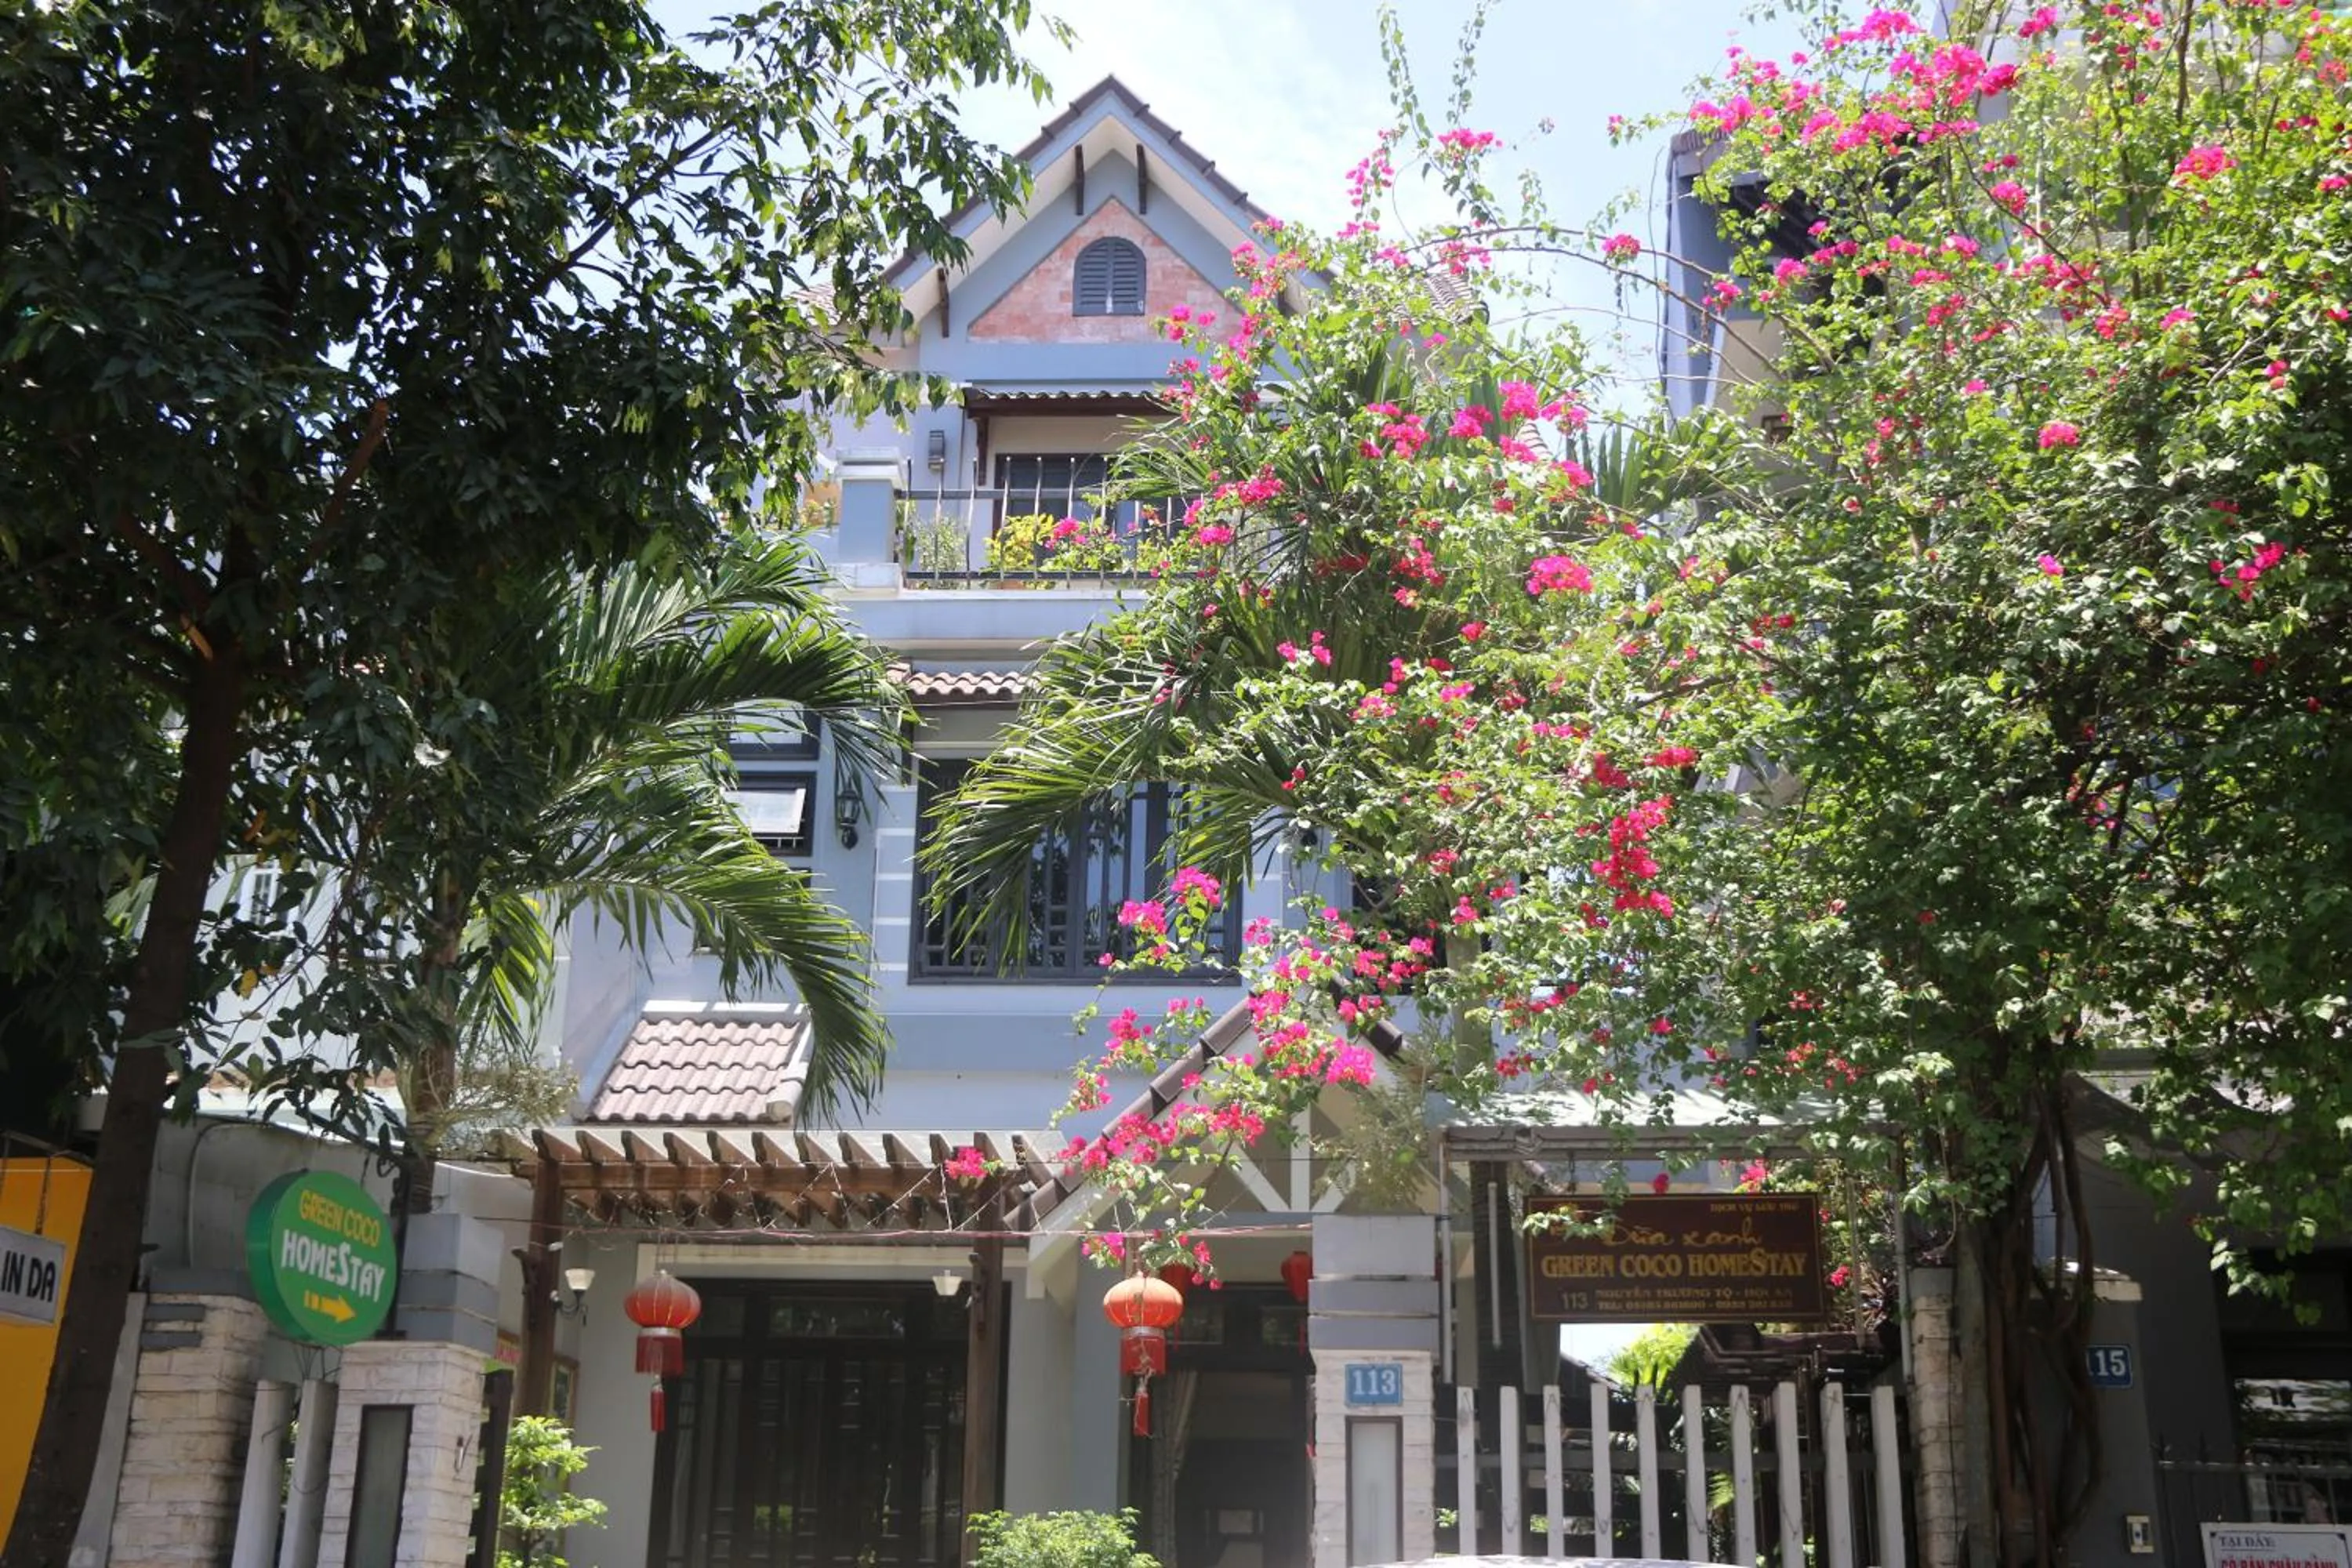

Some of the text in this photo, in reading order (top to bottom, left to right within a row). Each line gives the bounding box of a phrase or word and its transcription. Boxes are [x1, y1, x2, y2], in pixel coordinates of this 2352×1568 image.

[299, 1189, 381, 1247] GREEN COCO
[1541, 1254, 1616, 1278] GREEN
[1620, 1254, 1682, 1278] COCO
[26, 1257, 56, 1303] DA
[1561, 1291, 1589, 1310] 113
[1352, 1369, 1396, 1396] 113
